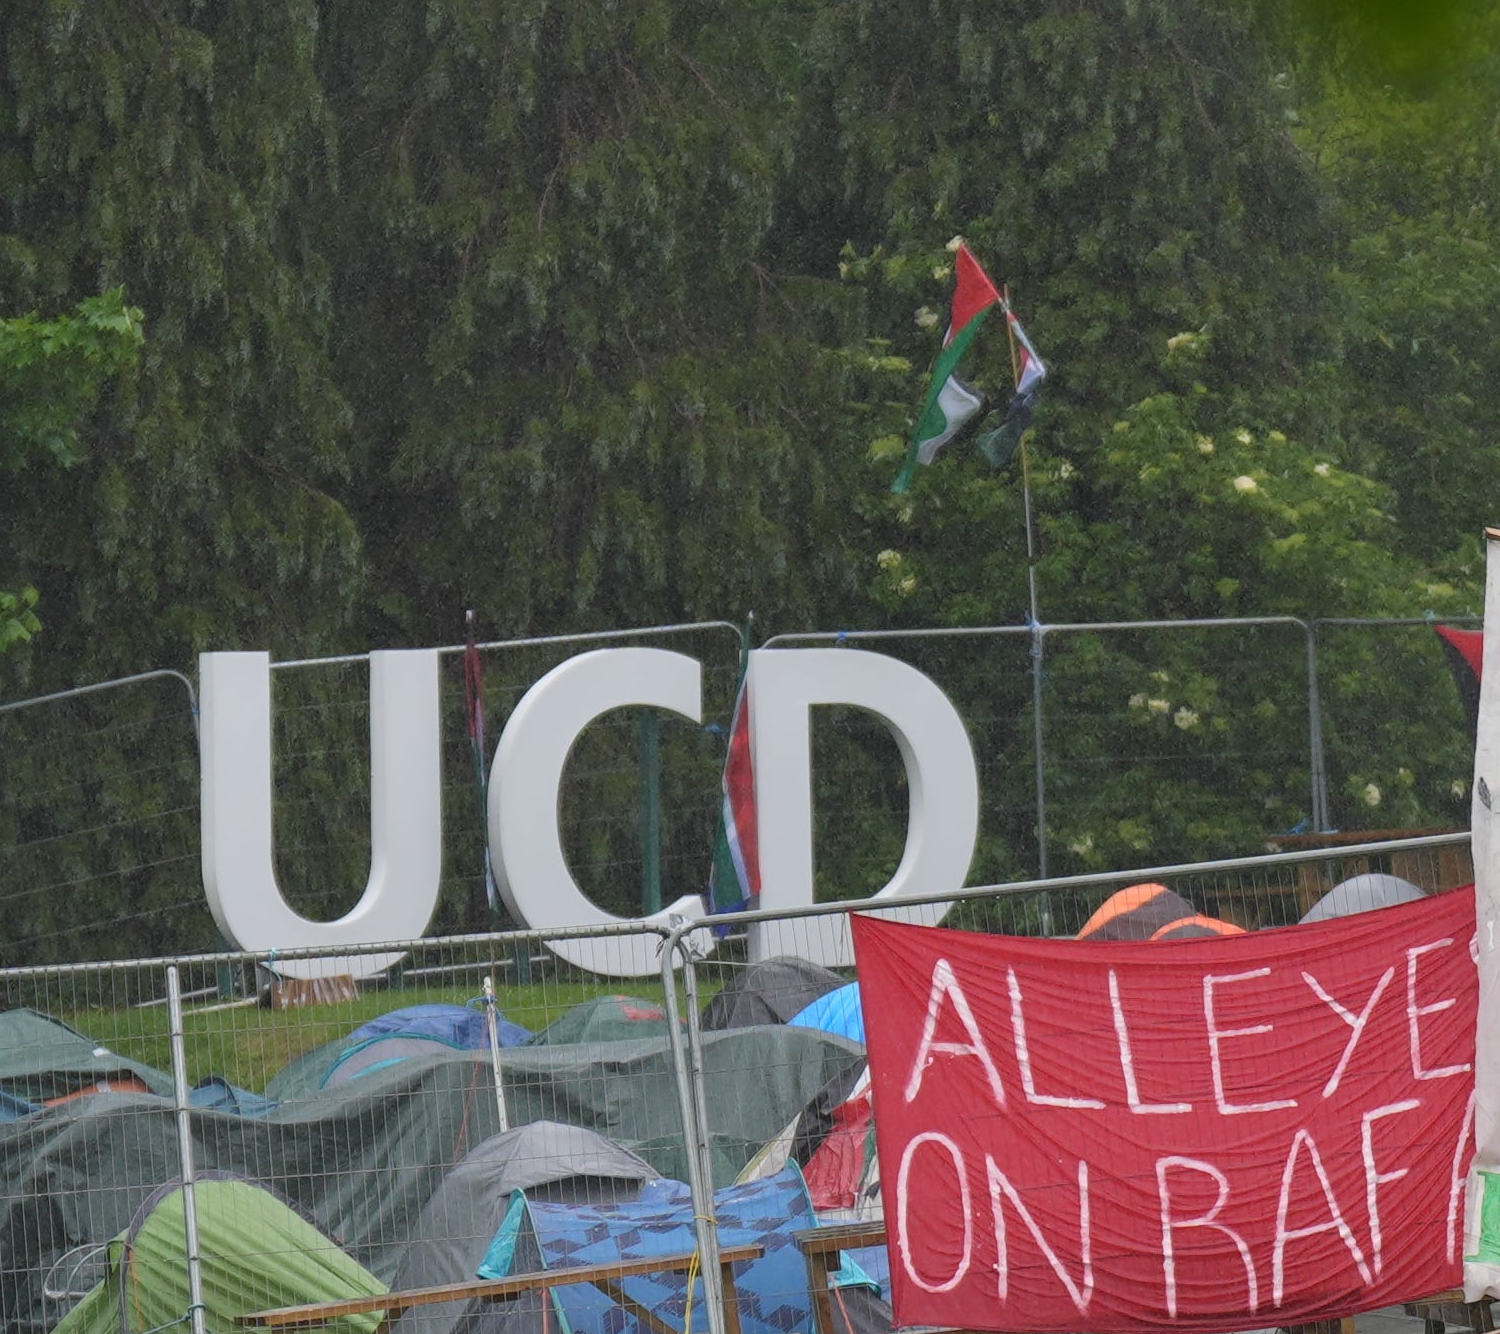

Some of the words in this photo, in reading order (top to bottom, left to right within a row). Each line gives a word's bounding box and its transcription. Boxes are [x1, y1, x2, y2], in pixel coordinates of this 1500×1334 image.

[199, 646, 980, 977] UCD
[1203, 931, 1478, 1115] EYE
[898, 1130, 1093, 1317] ON
